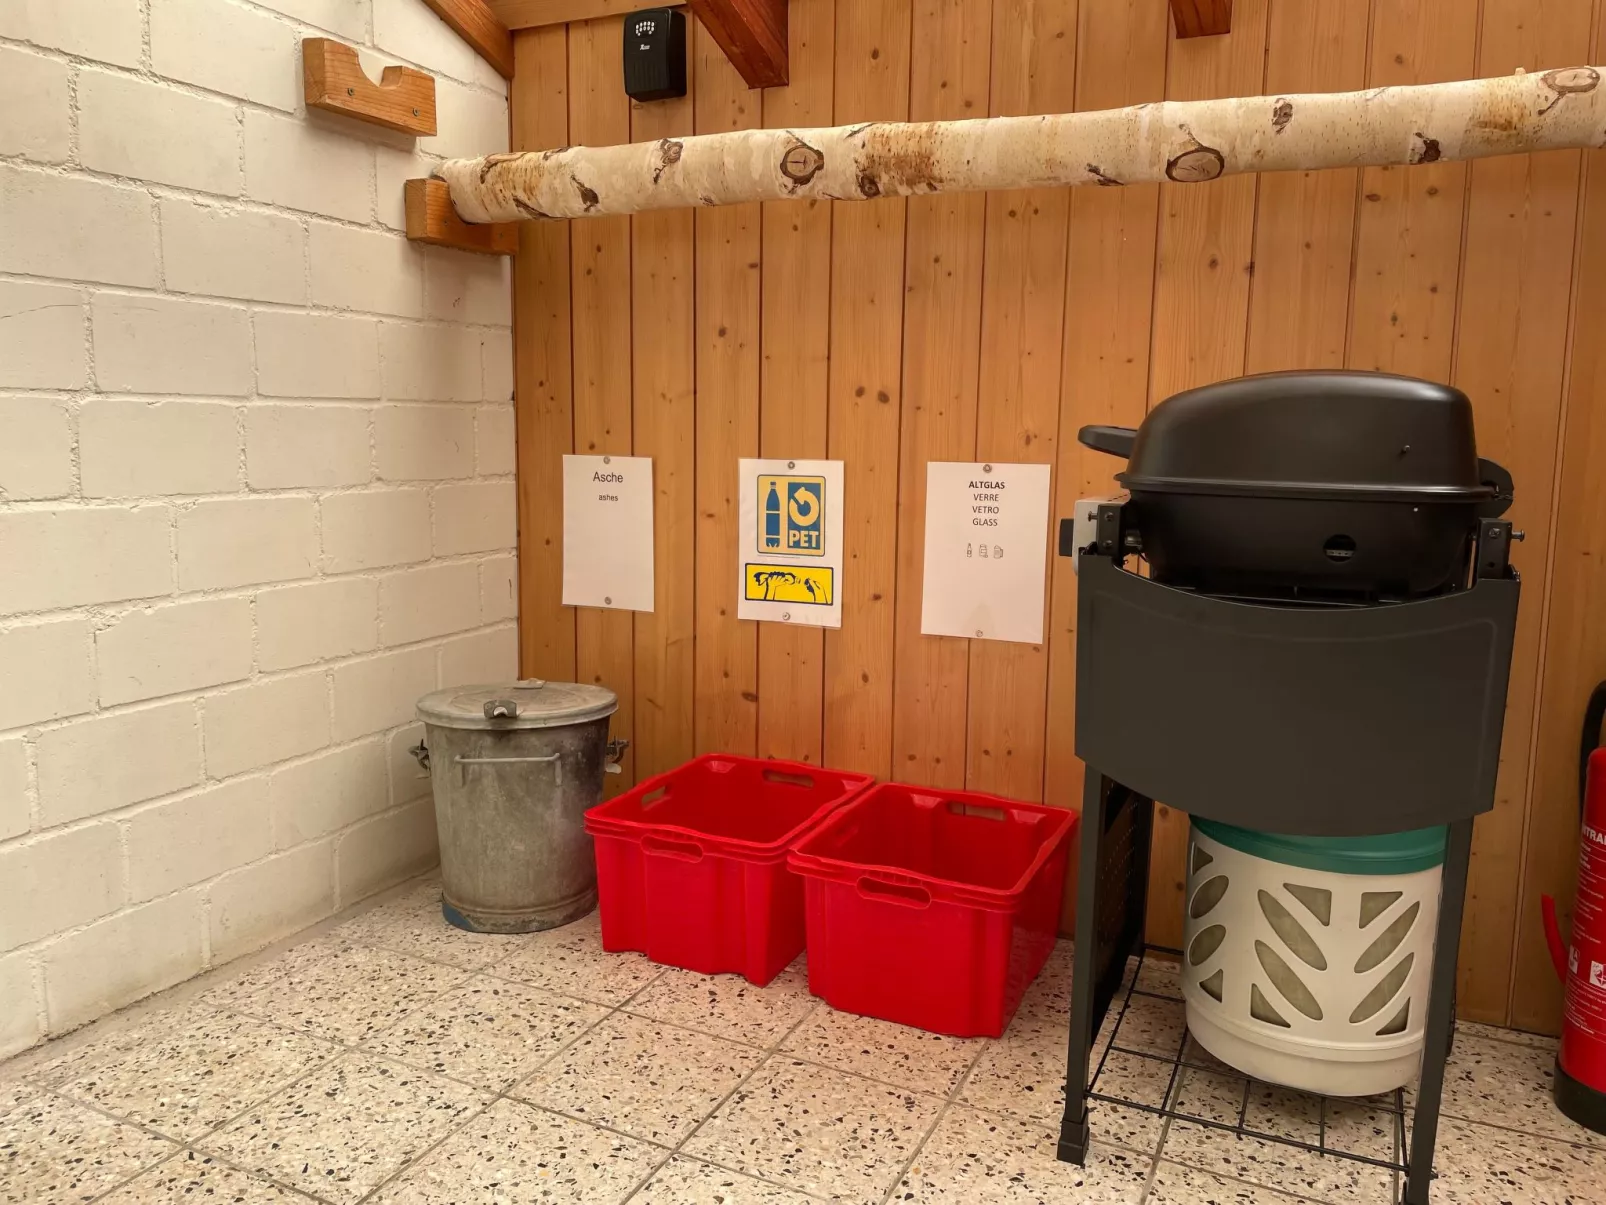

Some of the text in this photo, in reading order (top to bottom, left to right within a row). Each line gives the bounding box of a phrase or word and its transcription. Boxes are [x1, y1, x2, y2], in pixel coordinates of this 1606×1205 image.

[592, 471, 624, 483] Asche
[968, 480, 1006, 489] ALTGLAS
[598, 494, 619, 502] ashes
[973, 493, 1000, 502] VERRE
[972, 505, 1000, 514] VETRO
[972, 517, 998, 527] GLASS
[789, 530, 820, 548] PET
